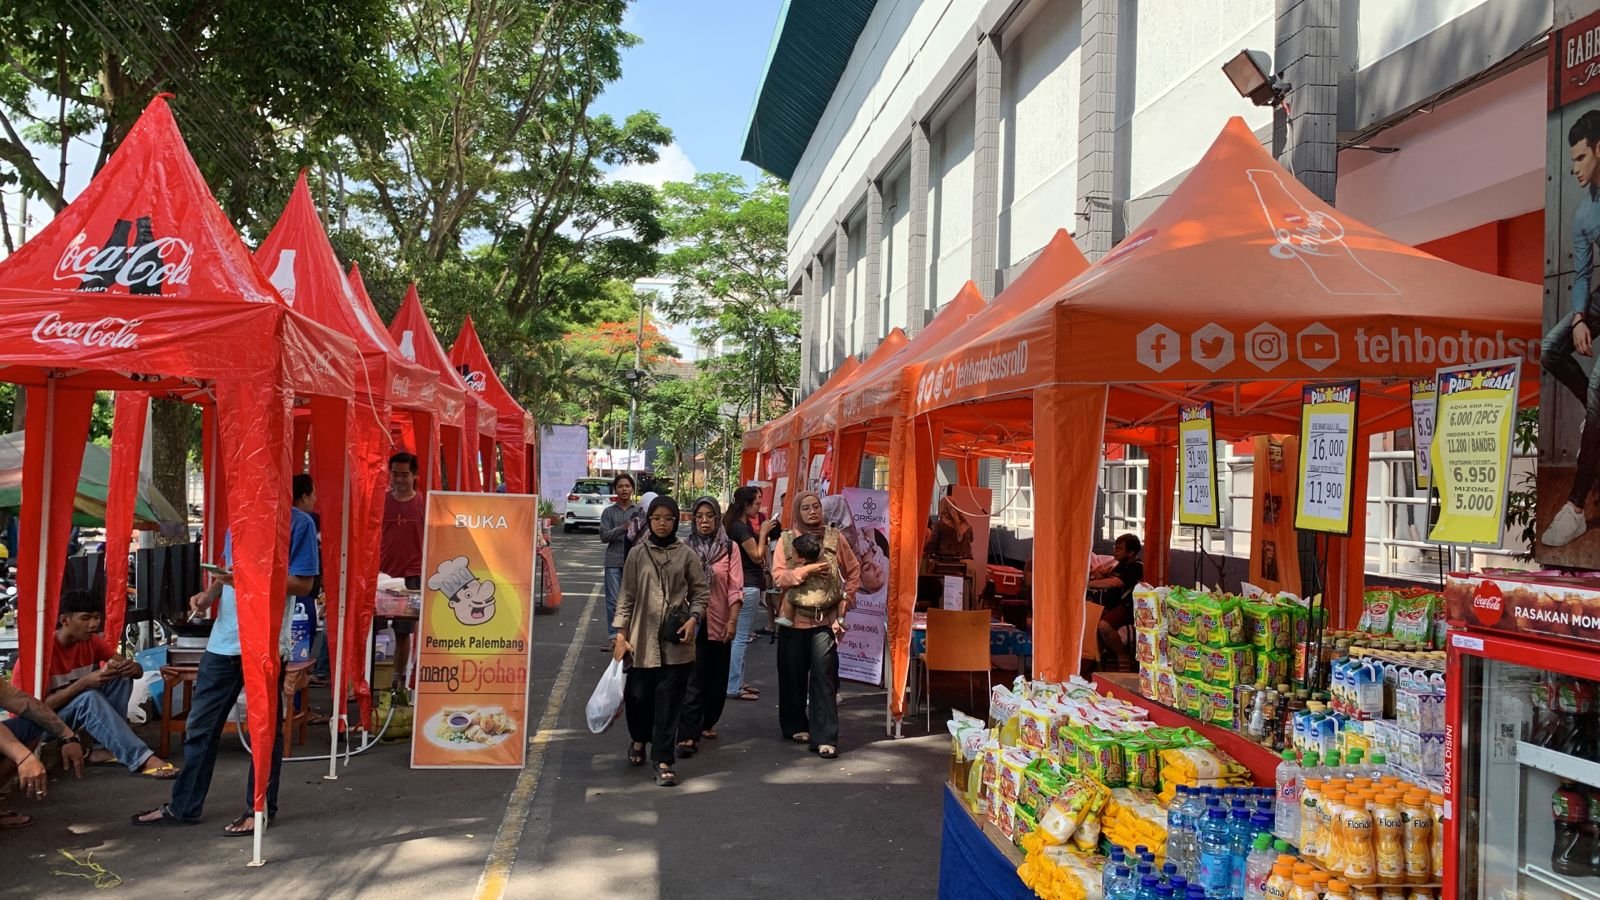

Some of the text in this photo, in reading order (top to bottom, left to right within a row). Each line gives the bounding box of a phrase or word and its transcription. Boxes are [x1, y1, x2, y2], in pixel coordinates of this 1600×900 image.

[956, 339, 1029, 389] tehbotolsosroID
[1449, 411, 1472, 427] 6.000
[1471, 437, 1497, 453] BANDED
[1453, 466, 1496, 483] 6.950
[455, 514, 508, 530] BUKA
[853, 513, 887, 524] ORISKIN
[1515, 606, 1568, 625] RASAKAN
[425, 636, 524, 652] Pempek Palembang
[419, 658, 527, 692] mang Djohan
[1444, 724, 1454, 794] BUKA DISINI
